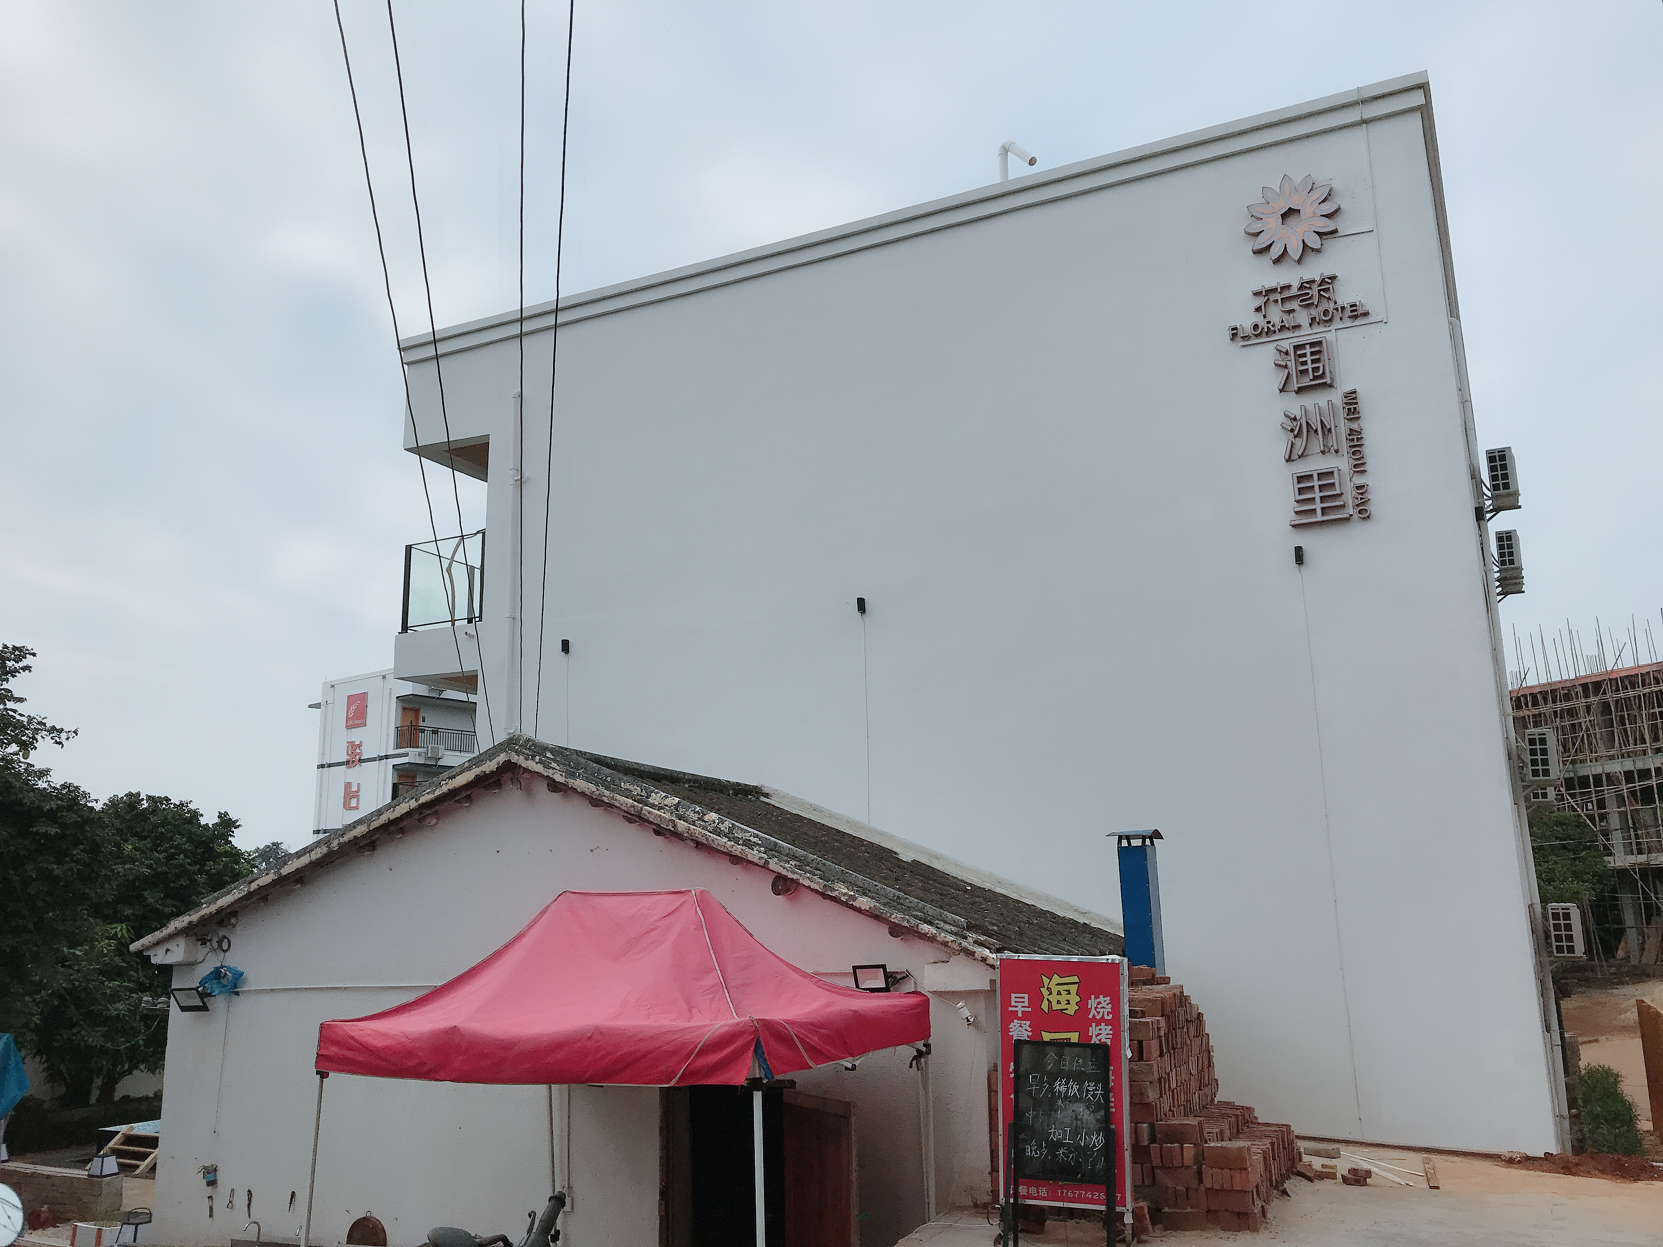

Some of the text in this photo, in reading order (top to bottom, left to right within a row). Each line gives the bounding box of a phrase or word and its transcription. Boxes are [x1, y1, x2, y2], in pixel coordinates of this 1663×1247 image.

[1228, 300, 1370, 341] FLORAL HOTEL
[1343, 388, 1371, 519] WEI ZHOU DAO
[1039, 972, 1082, 1043] 海
[1088, 995, 1113, 1046] 烧烤
